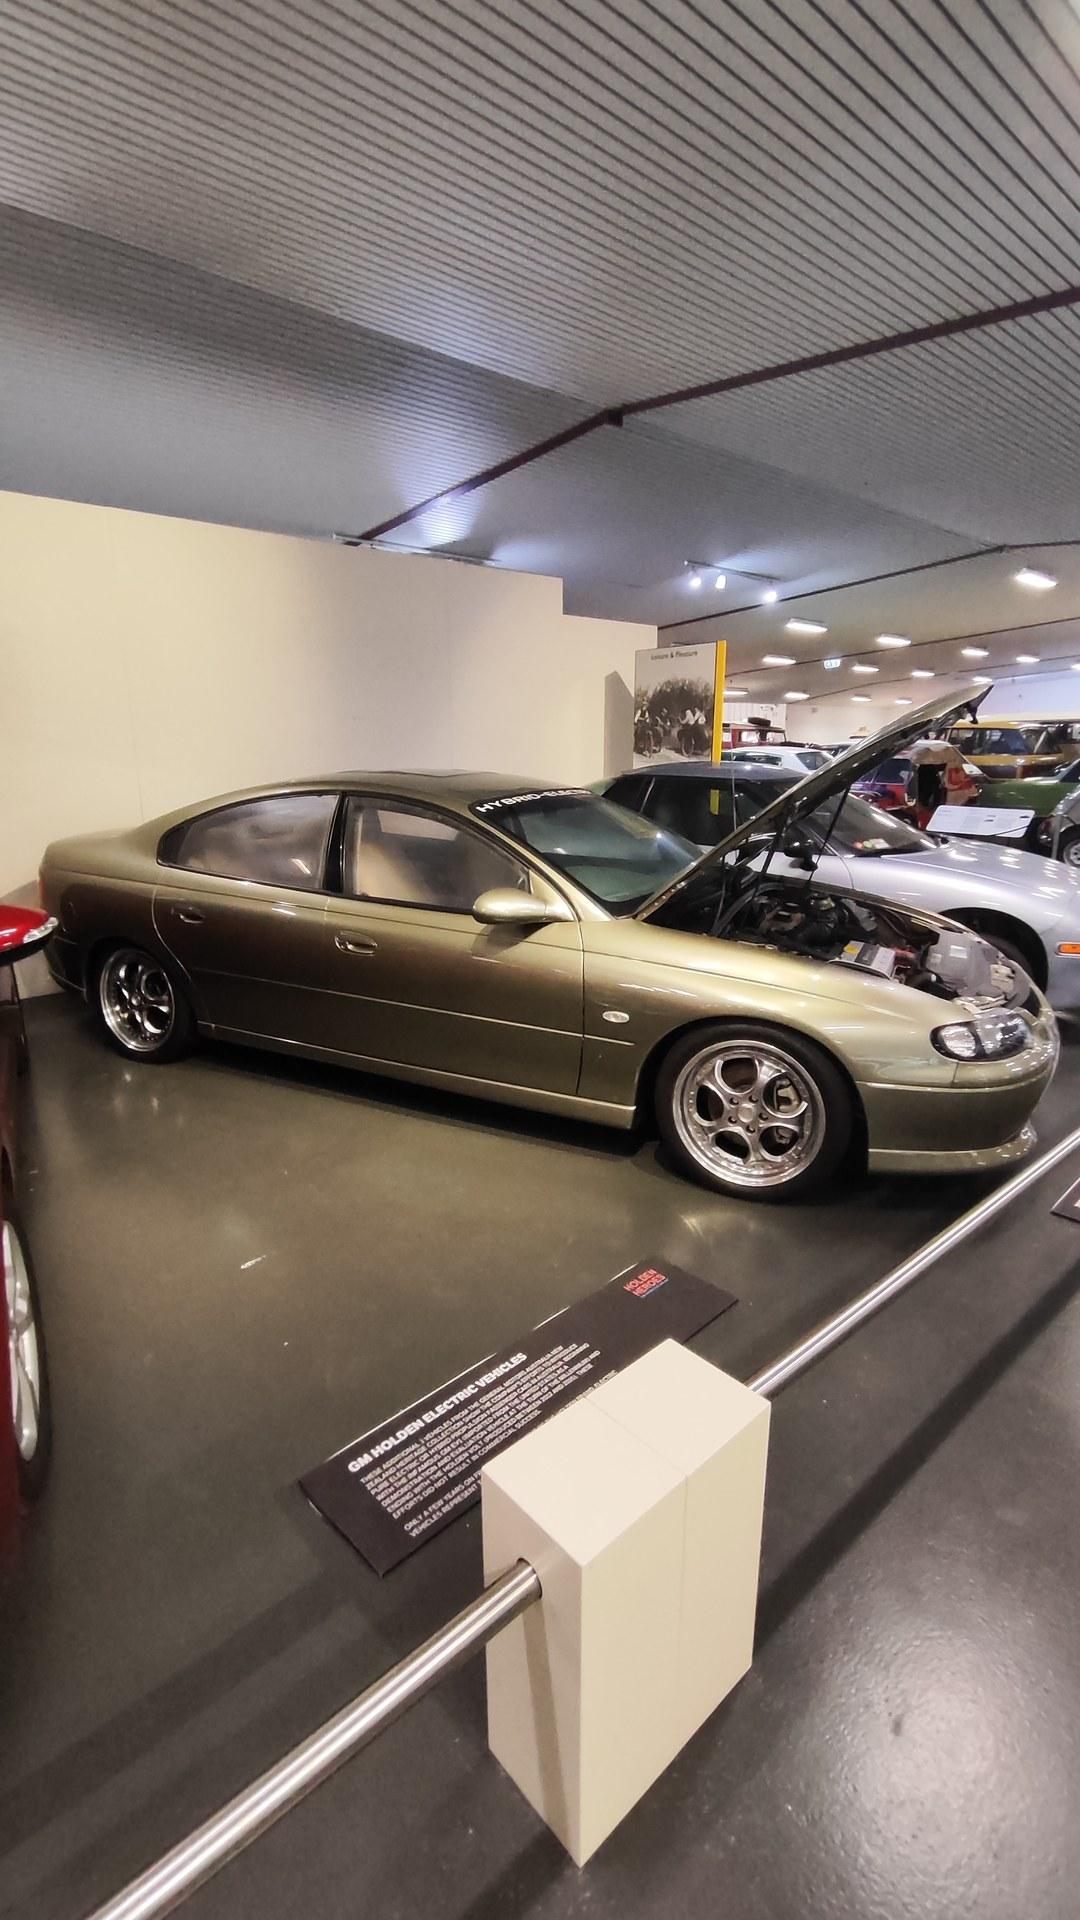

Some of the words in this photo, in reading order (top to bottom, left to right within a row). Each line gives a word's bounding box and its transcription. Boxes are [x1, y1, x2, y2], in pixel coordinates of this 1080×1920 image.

[623, 1269, 657, 1291] HOLDEN
[347, 1452, 374, 1473] GM
[370, 1418, 426, 1458] HOLDEN
[422, 1382, 479, 1424] ELECTRIC
[475, 1351, 528, 1389] VEHICLES
[359, 1466, 383, 1484] THESE
[381, 1441, 420, 1469] ADDITIONAL
[423, 1419, 453, 1441] VEHICLES
[451, 1408, 470, 1423] FROM
[467, 1400, 481, 1411] THE
[525, 1352, 552, 1372] AUSTRALIA
[364, 1465, 397, 1490] ZEALAND
[395, 1444, 428, 1469] HERITAGE
[426, 1419, 465, 1448] COLLECTION
[479, 1400, 493, 1411] THE
[520, 1365, 545, 1383] EFFORTS
[542, 1360, 552, 1368] TO
[370, 1479, 390, 1495] PURE
[388, 1458, 420, 1483] ELECTRIC
[418, 1451, 430, 1462] OR
[428, 1436, 452, 1455] HYBRID
[450, 1412, 488, 1440] PROPULSION
[517, 1381, 532, 1394] CARS
[530, 1377, 538, 1385] IN
[375, 1485, 396, 1501] WITH
[393, 1476, 409, 1489] THE
[406, 1452, 442, 1480] INFAMOUS
[440, 1445, 452, 1456] GM
[492, 1404, 511, 1419] FROM
[509, 1397, 521, 1408] THE
[380, 1463, 439, 1507] DEMONSTRATION
[436, 1454, 452, 1467] AND
[449, 1428, 488, 1458] EVALUATION
[486, 1413, 511, 1432] VEHICLE
[508, 1408, 518, 1416] AT
[516, 1400, 529, 1411] THE
[527, 1390, 543, 1403] TURN
[541, 1385, 550, 1394] OF
[548, 1377, 561, 1388] THE
[589, 1349, 601, 1359] AND
[386, 1490, 414, 1513] ENDING
[412, 1478, 432, 1494] WITH
[429, 1469, 444, 1482] THE
[442, 1450, 470, 1473] HOLDEN
[468, 1440, 485, 1454] VOLT
[515, 1399, 543, 1420] BETWEEN
[552, 1382, 565, 1394] AND
[576, 1362, 594, 1376] THESE
[391, 1493, 424, 1519] EFFORTS
[421, 1485, 436, 1497] DID
[433, 1475, 450, 1489] NOT
[447, 1458, 472, 1478] RESULT
[470, 1453, 480, 1462] IN
[477, 1426, 517, 1457] COMMERCIAL
[403, 1513, 424, 1531] ONLY
[422, 1509, 430, 1517] A
[427, 1498, 445, 1513] FEW
[443, 1482, 465, 1502] YEARS
[463, 1475, 476, 1487] ON
[409, 1509, 444, 1538] VEHICLES
[441, 1482, 479, 1514] REPRESENT
